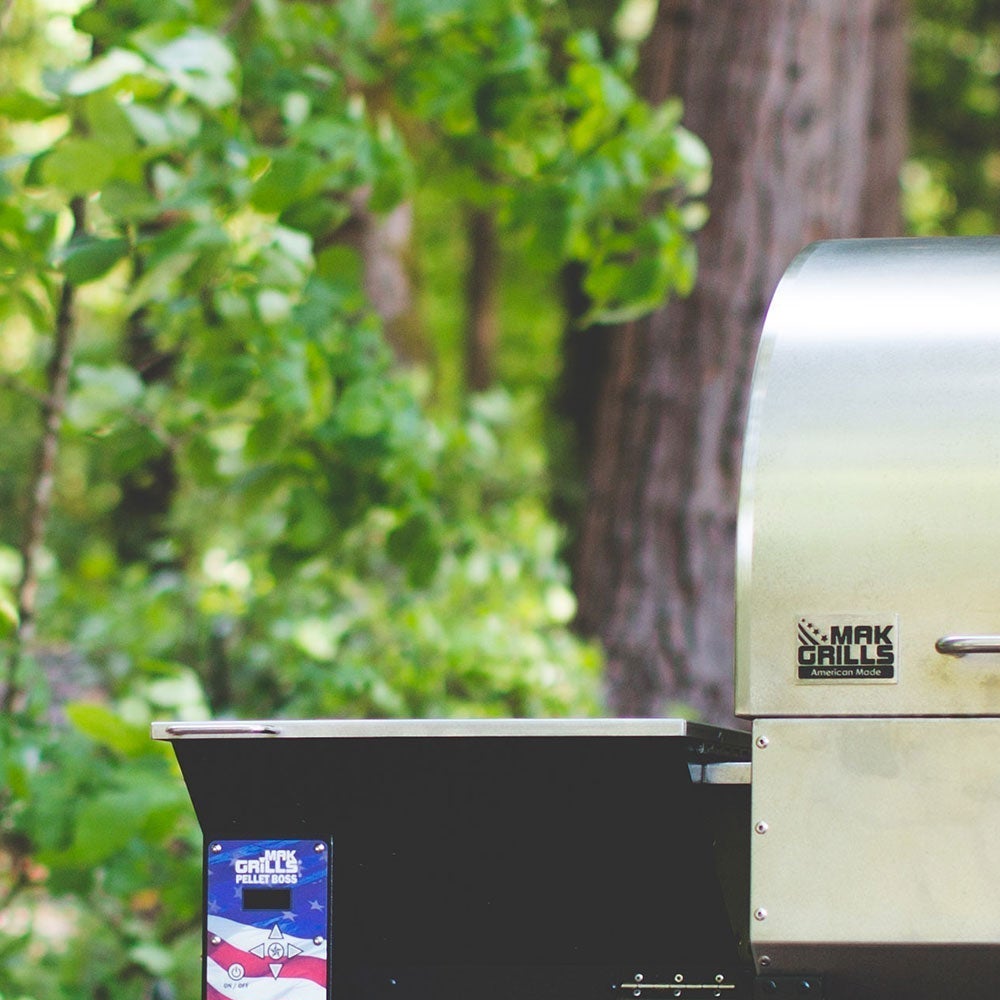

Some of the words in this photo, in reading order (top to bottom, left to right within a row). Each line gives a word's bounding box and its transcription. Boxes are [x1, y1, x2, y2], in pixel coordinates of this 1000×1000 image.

[830, 625, 893, 644] MAK
[798, 645, 894, 664] GRILLS
[265, 850, 297, 861] MAK
[235, 874, 270, 884] PELLET
[271, 874, 298, 884] BOSS
